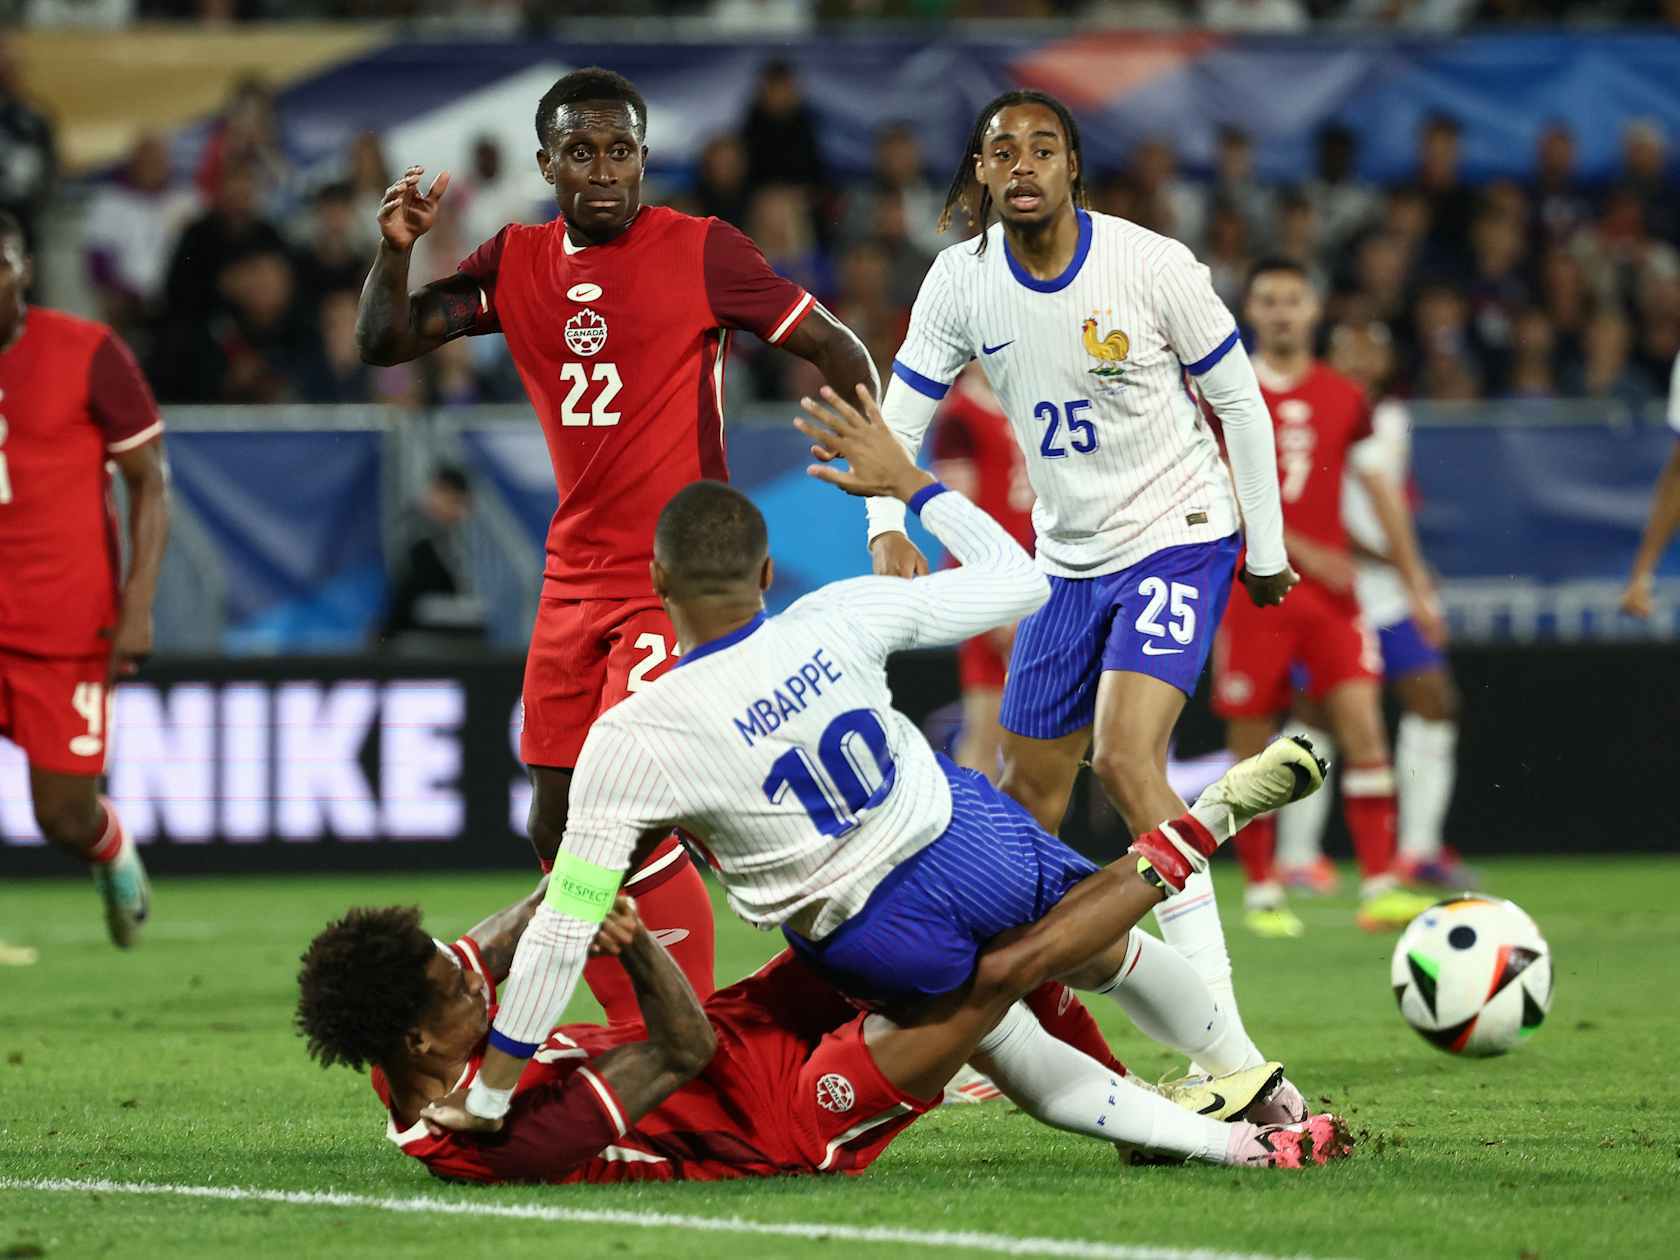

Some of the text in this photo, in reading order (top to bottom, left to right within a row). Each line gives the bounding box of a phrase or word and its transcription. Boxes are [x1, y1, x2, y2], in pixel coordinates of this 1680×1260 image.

[566, 327, 605, 339] CANADA
[560, 363, 624, 426] 22
[1033, 400, 1099, 459] 25
[1135, 576, 1199, 645] 25
[626, 632, 680, 693] 2
[732, 648, 842, 747] MBAPPE
[108, 680, 465, 842] NIKE
[762, 708, 896, 838] 10
[562, 879, 610, 903] RESPECT
